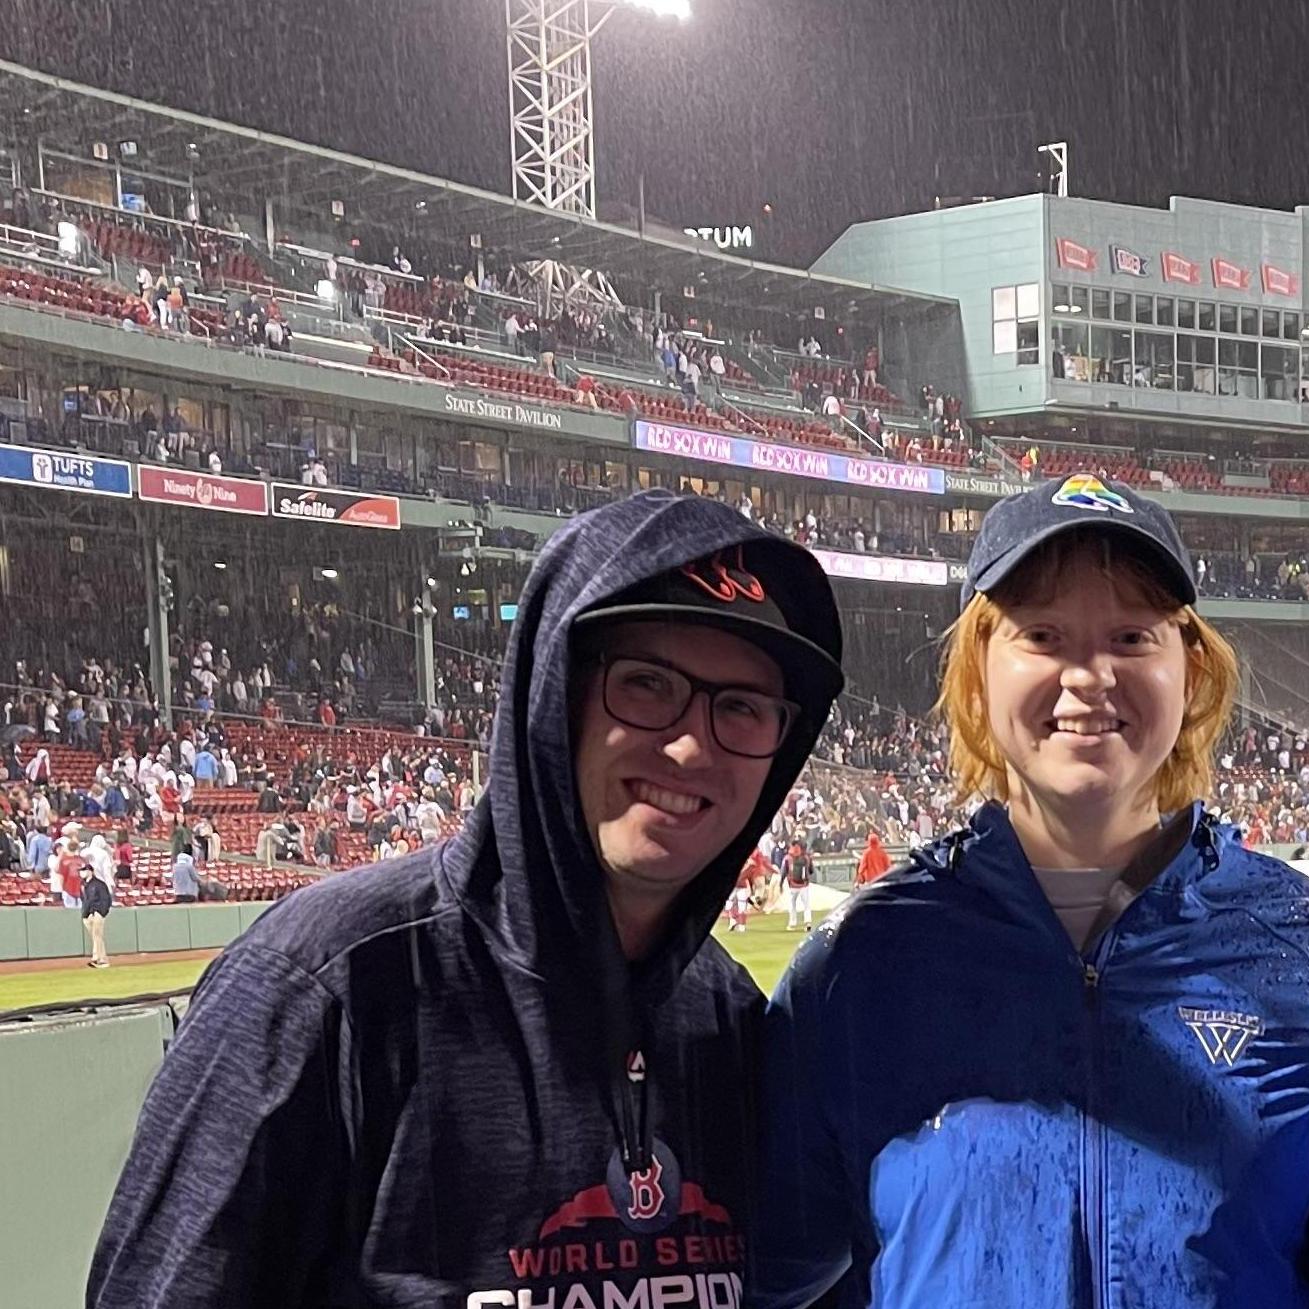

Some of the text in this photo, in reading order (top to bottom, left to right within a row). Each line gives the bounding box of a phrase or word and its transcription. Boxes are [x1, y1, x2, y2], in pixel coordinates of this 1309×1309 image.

[445, 394, 561, 428] STATE STREET PAVILION
[647, 426, 731, 459] RED SOX WIN
[52, 455, 94, 477] TUFTS
[752, 445, 828, 475] RED SOX WIN
[847, 461, 928, 489] RED SOX WIN
[164, 479, 196, 499] Ninety
[280, 498, 336, 519] Safelite
[627, 1153, 665, 1220] B
[509, 1239, 638, 1278] WORLD
